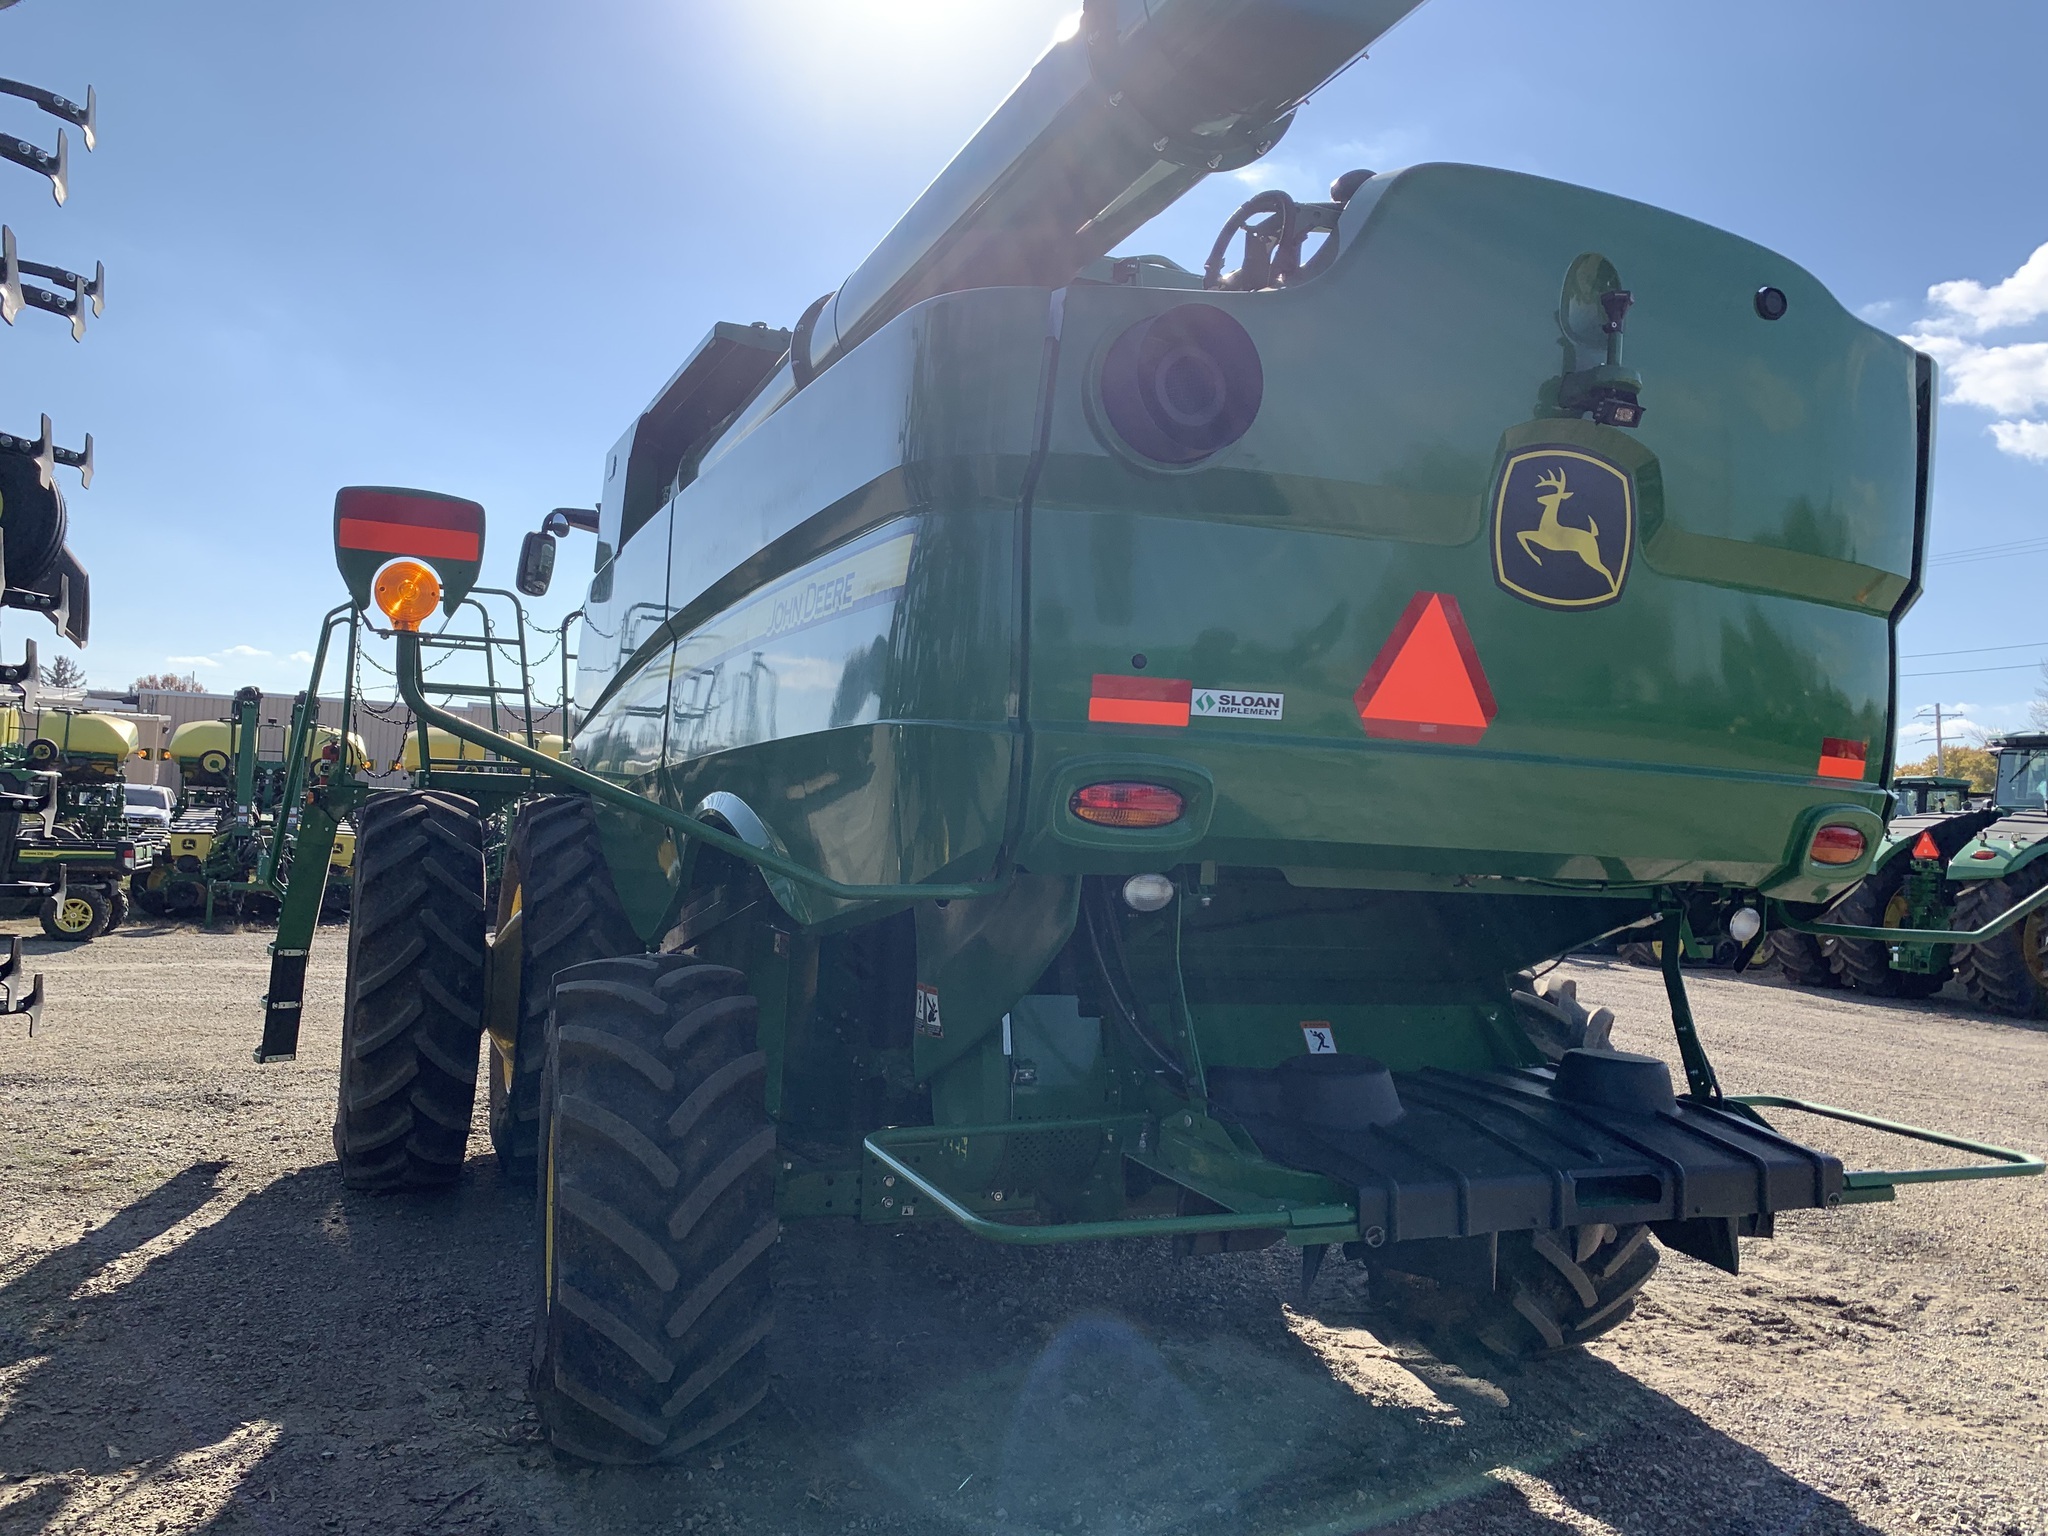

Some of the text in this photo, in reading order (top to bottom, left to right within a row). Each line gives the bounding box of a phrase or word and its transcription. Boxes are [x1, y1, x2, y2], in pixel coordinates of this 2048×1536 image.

[766, 572, 856, 635] JOHN DEERE
[1219, 694, 1280, 708] SLOAN
[1218, 706, 1280, 716] IMPLEMENT
